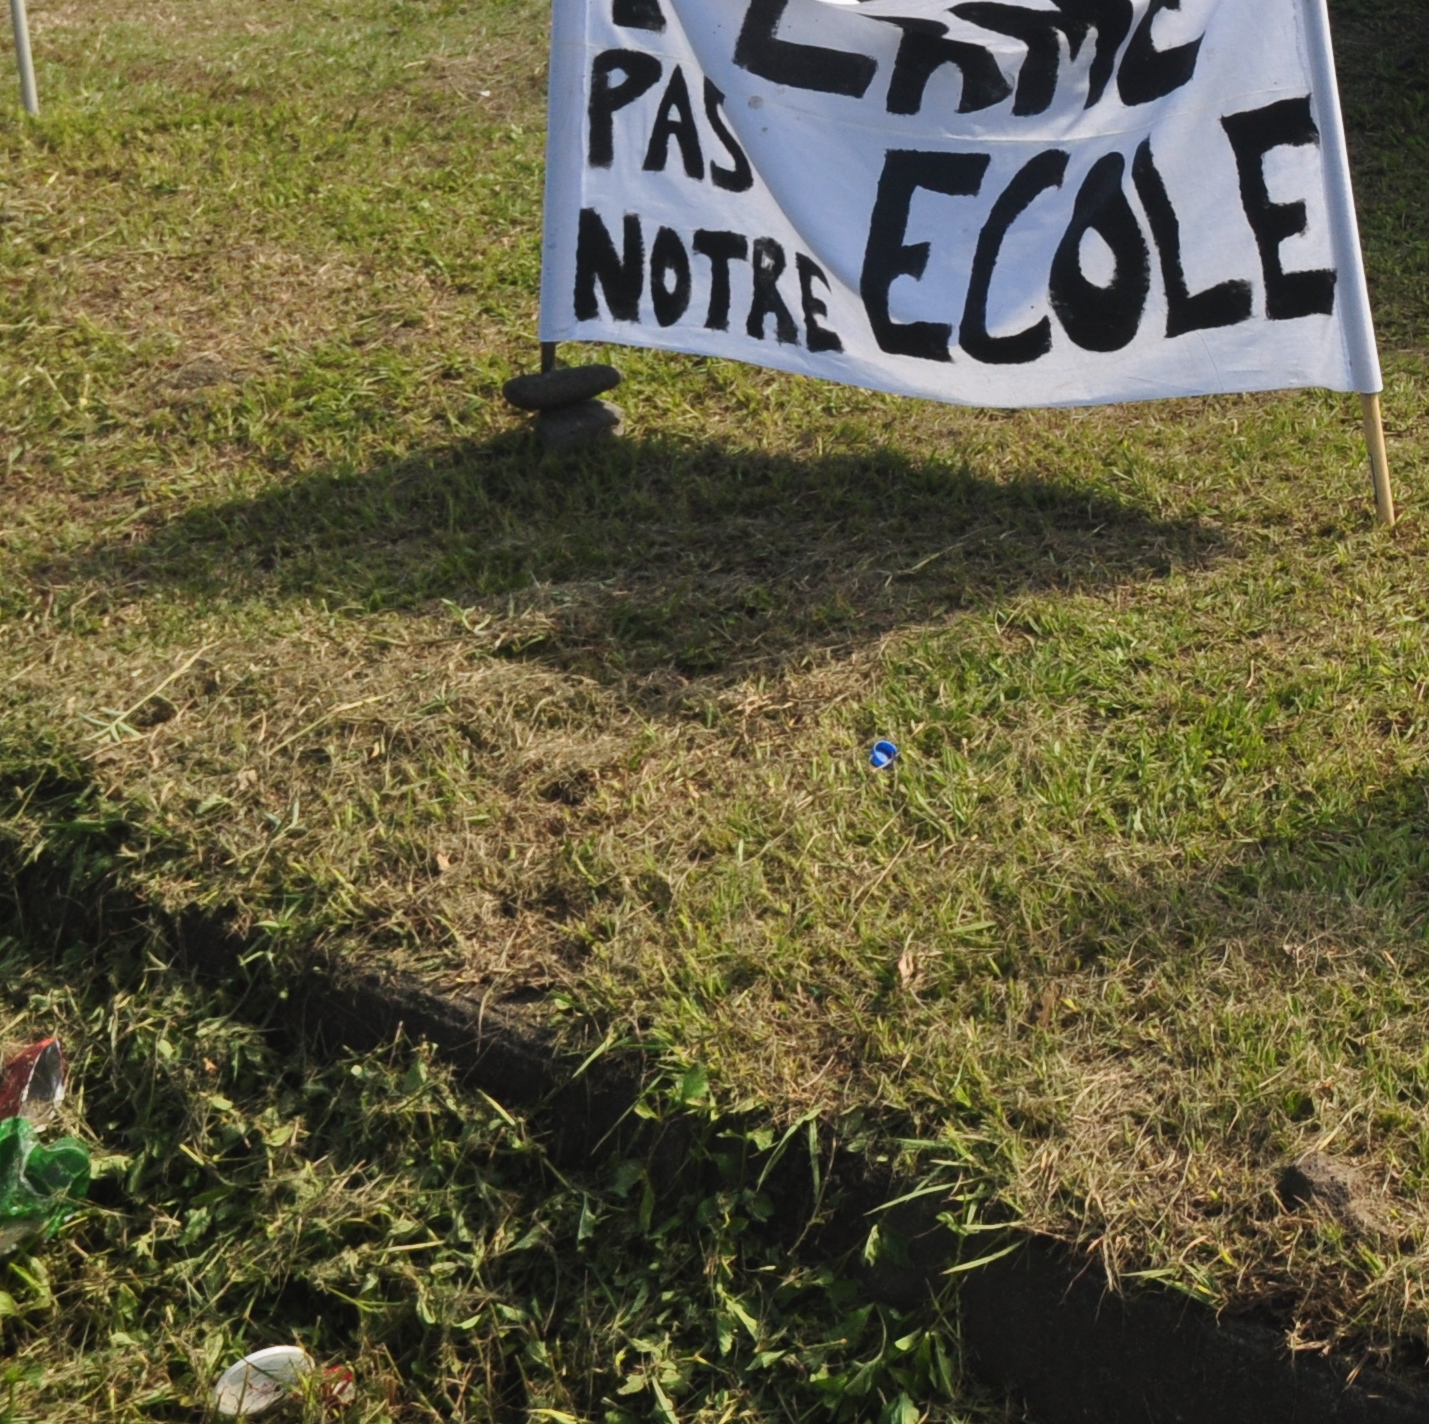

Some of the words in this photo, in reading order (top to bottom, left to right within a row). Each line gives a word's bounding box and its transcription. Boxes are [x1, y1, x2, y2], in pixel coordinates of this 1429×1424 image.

[587, 48, 755, 193] PAS
[573, 206, 845, 354] NOTRE
[860, 93, 1338, 365] ECOLE
